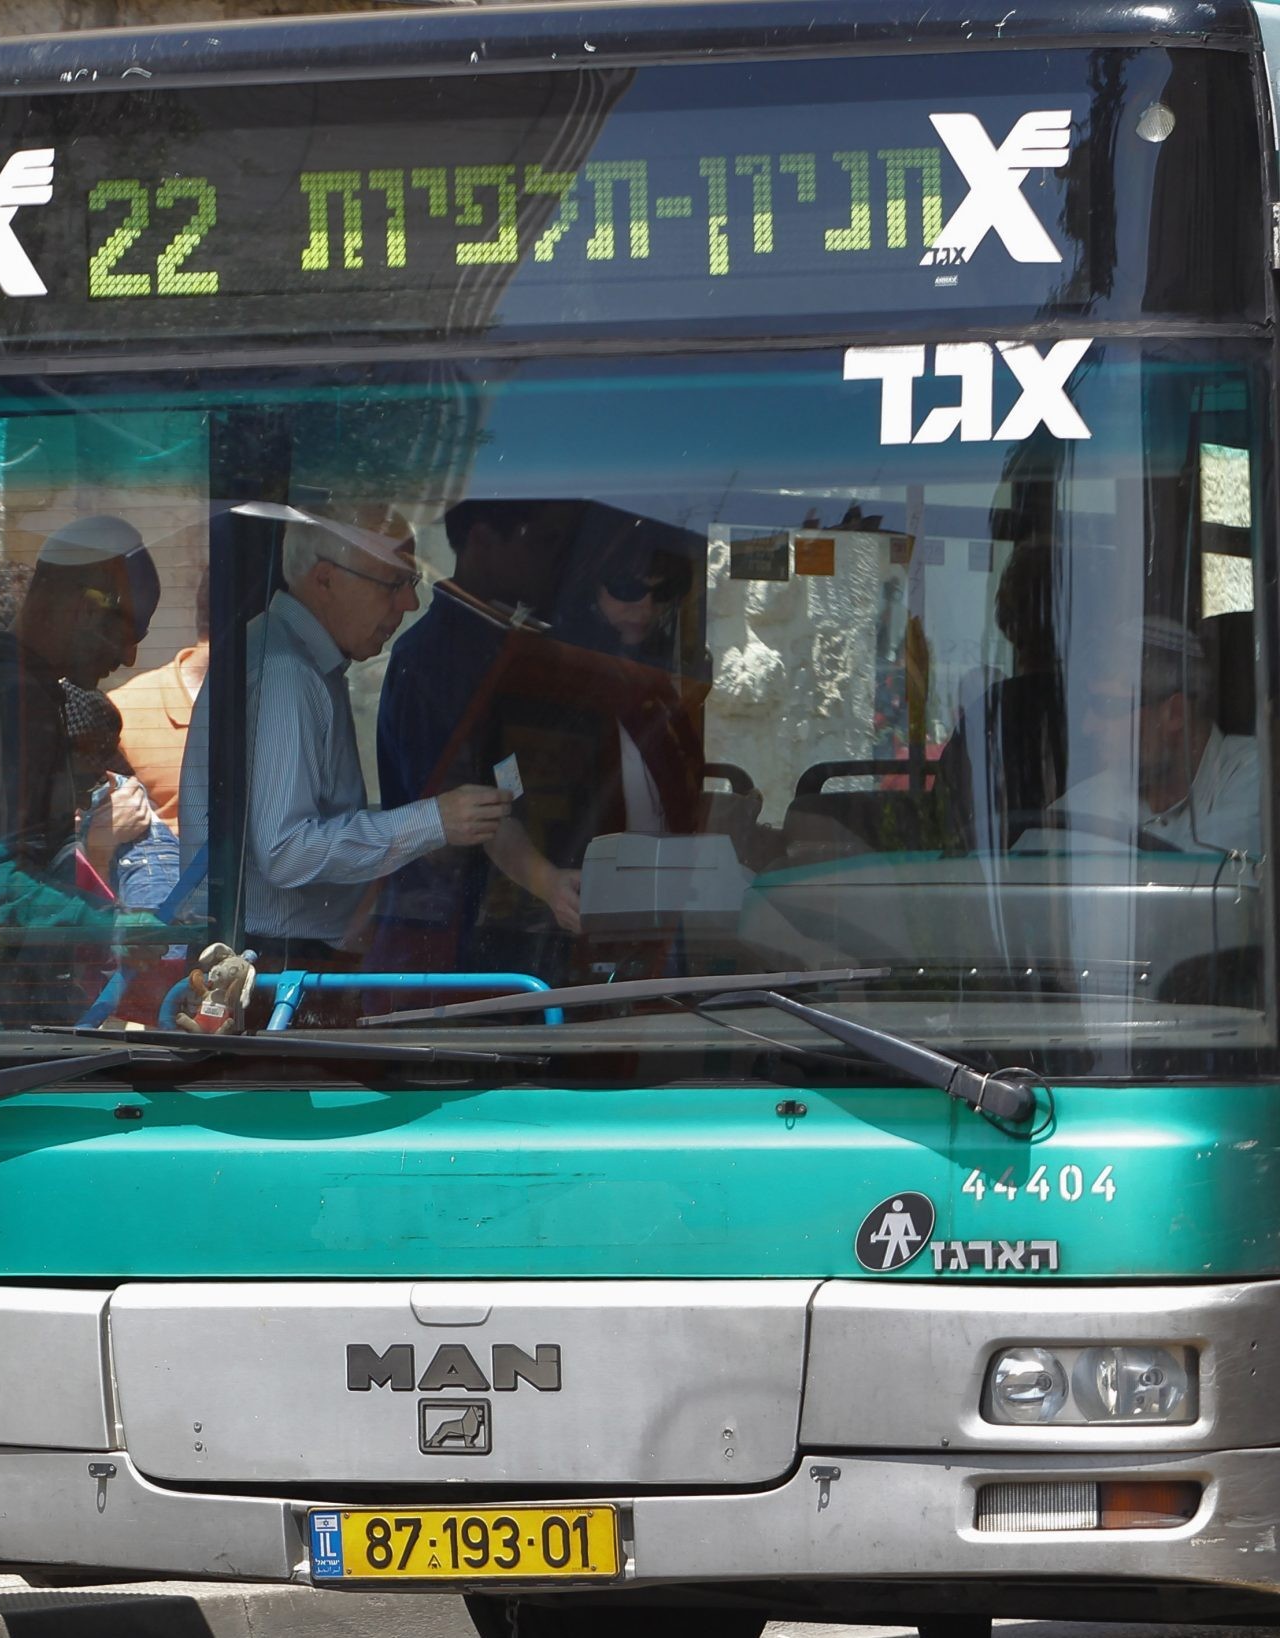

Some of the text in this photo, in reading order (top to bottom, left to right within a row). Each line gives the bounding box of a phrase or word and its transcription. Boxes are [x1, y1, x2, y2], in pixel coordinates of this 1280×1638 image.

[89, 177, 219, 297] 22
[843, 337, 1094, 445] אגד
[962, 1165, 1117, 1202] 44404
[931, 1240, 1059, 1271] הארגז
[346, 1343, 562, 1393] MAN
[319, 1532, 337, 1557] IL
